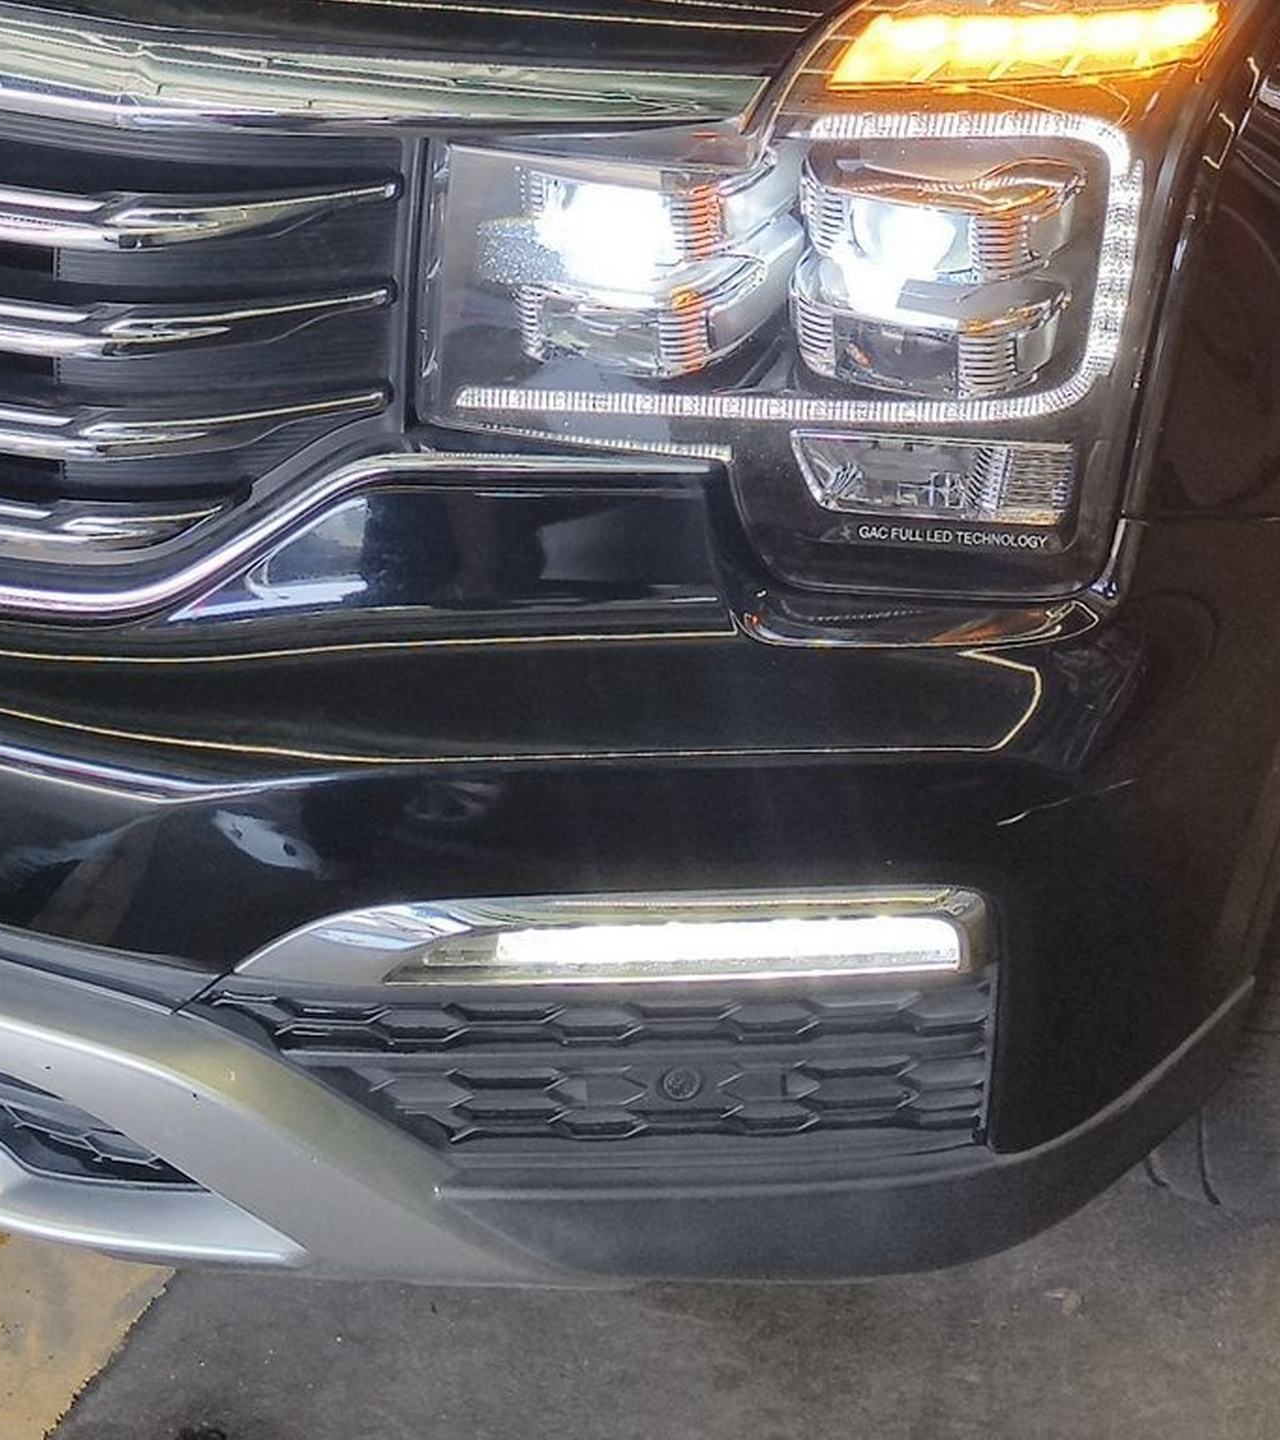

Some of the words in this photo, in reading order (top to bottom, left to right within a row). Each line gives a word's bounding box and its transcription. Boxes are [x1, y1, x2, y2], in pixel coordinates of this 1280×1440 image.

[858, 526, 888, 539] GAC
[890, 528, 923, 541] FULL
[926, 530, 952, 543] LED
[955, 531, 1048, 548] TECHNOLOGY
